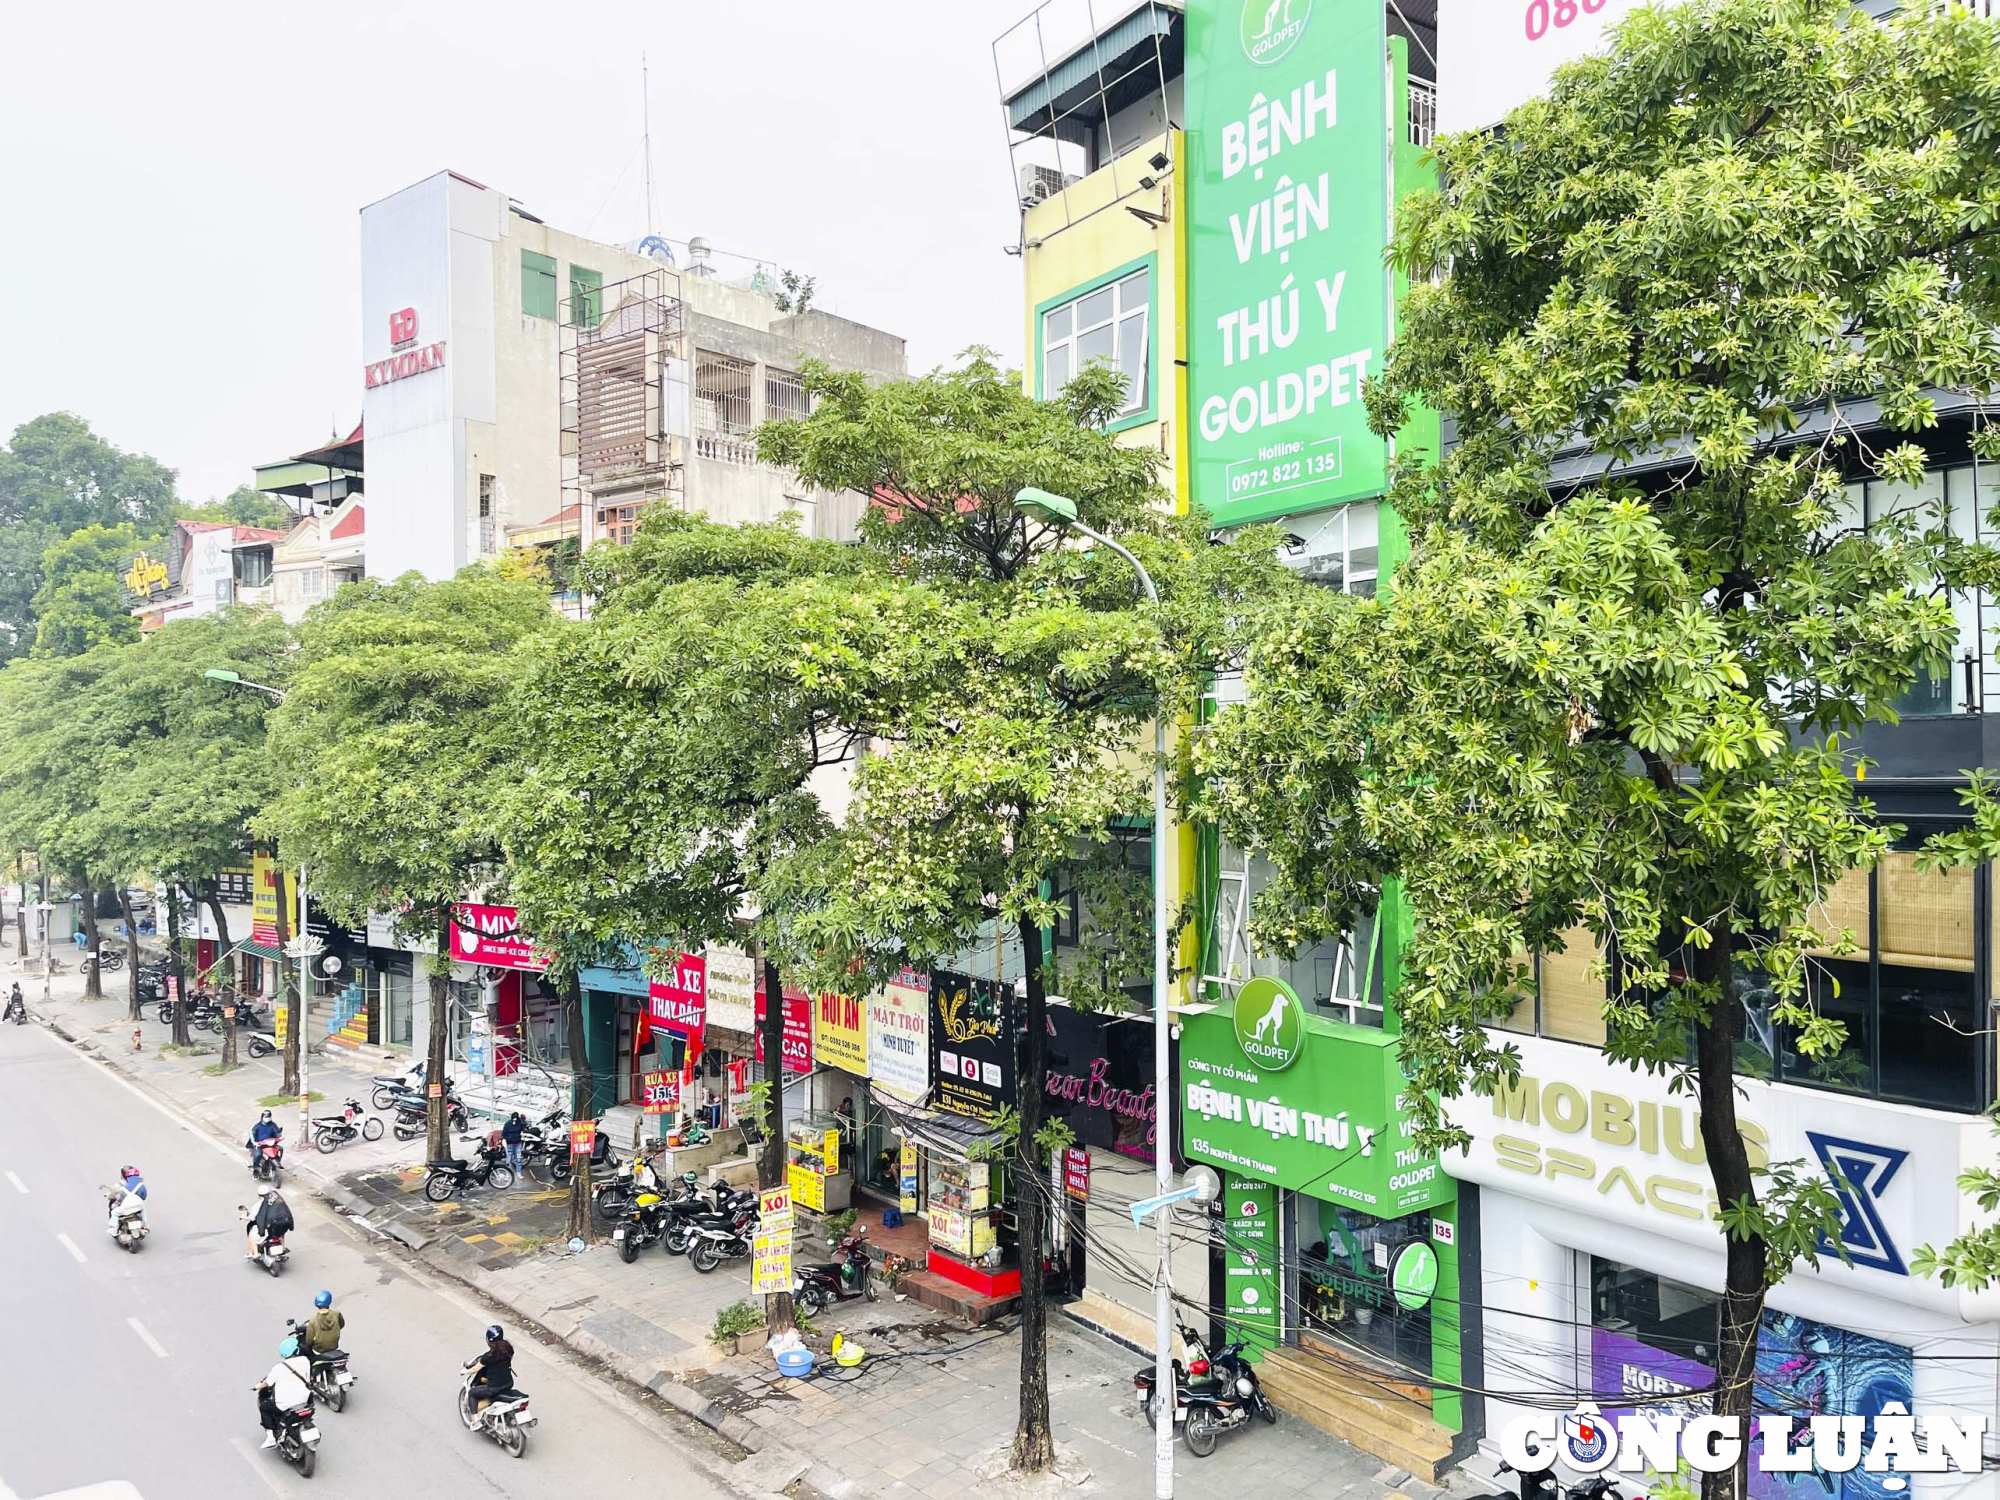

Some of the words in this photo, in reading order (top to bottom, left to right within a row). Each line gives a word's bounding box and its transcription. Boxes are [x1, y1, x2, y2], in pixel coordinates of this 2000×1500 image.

[1252, 19, 1301, 57] GOLDPET
[1222, 68, 1338, 181] BỆNH
[1229, 172, 1329, 264] VIỆN
[1217, 274, 1299, 366] THÚ
[1315, 270, 1347, 333] Y
[363, 340, 447, 390] KYMDAN
[1200, 348, 1372, 443] GOLDPET
[1258, 440, 1304, 461] Hotline:
[1232, 469, 1268, 493] 0972
[1272, 461, 1301, 483] 822
[1306, 452, 1335, 475] 135
[682, 969, 701, 993] XE
[652, 997, 676, 1020] THAY
[678, 998, 700, 1027] DẦU
[844, 999, 859, 1032] AN
[1244, 1041, 1290, 1061] GOLDPET
[645, 1071, 663, 1085] RỬA
[665, 1071, 678, 1084] XE
[1188, 1058, 1210, 1072] CÔNG
[1211, 1064, 1221, 1075] TY
[1222, 1064, 1234, 1078] CỔ
[1235, 1069, 1258, 1083] PHẦN
[653, 1086, 672, 1100] 15k
[1187, 1079, 1242, 1122] BỆNH
[1246, 1095, 1298, 1140] VIỆN
[1301, 1111, 1349, 1151] THÚ
[1355, 1125, 1375, 1157] Y
[1069, 1148, 1086, 1162] CHO
[1192, 1137, 1209, 1154] 135
[1210, 1149, 1238, 1164] NGUYỄN
[1239, 1156, 1251, 1167] CHÍ
[1251, 1160, 1277, 1175] THANH
[1068, 1160, 1088, 1177] THUÊ
[1389, 1164, 1436, 1191] GOLDPET
[1492, 1134, 1724, 1226] SPAC
[1069, 1174, 1086, 1190] NHÀ
[1254, 1182, 1267, 1190] 24/7
[1328, 1183, 1348, 1196] 0972
[1348, 1188, 1364, 1200] 822
[1364, 1193, 1377, 1204] 135
[763, 1192, 789, 1213] XÔI
[1211, 1200, 1222, 1212] 133
[931, 1213, 947, 1234] XÔI
[1434, 1223, 1452, 1239] 135
[1310, 1267, 1384, 1308] GOLDPET
